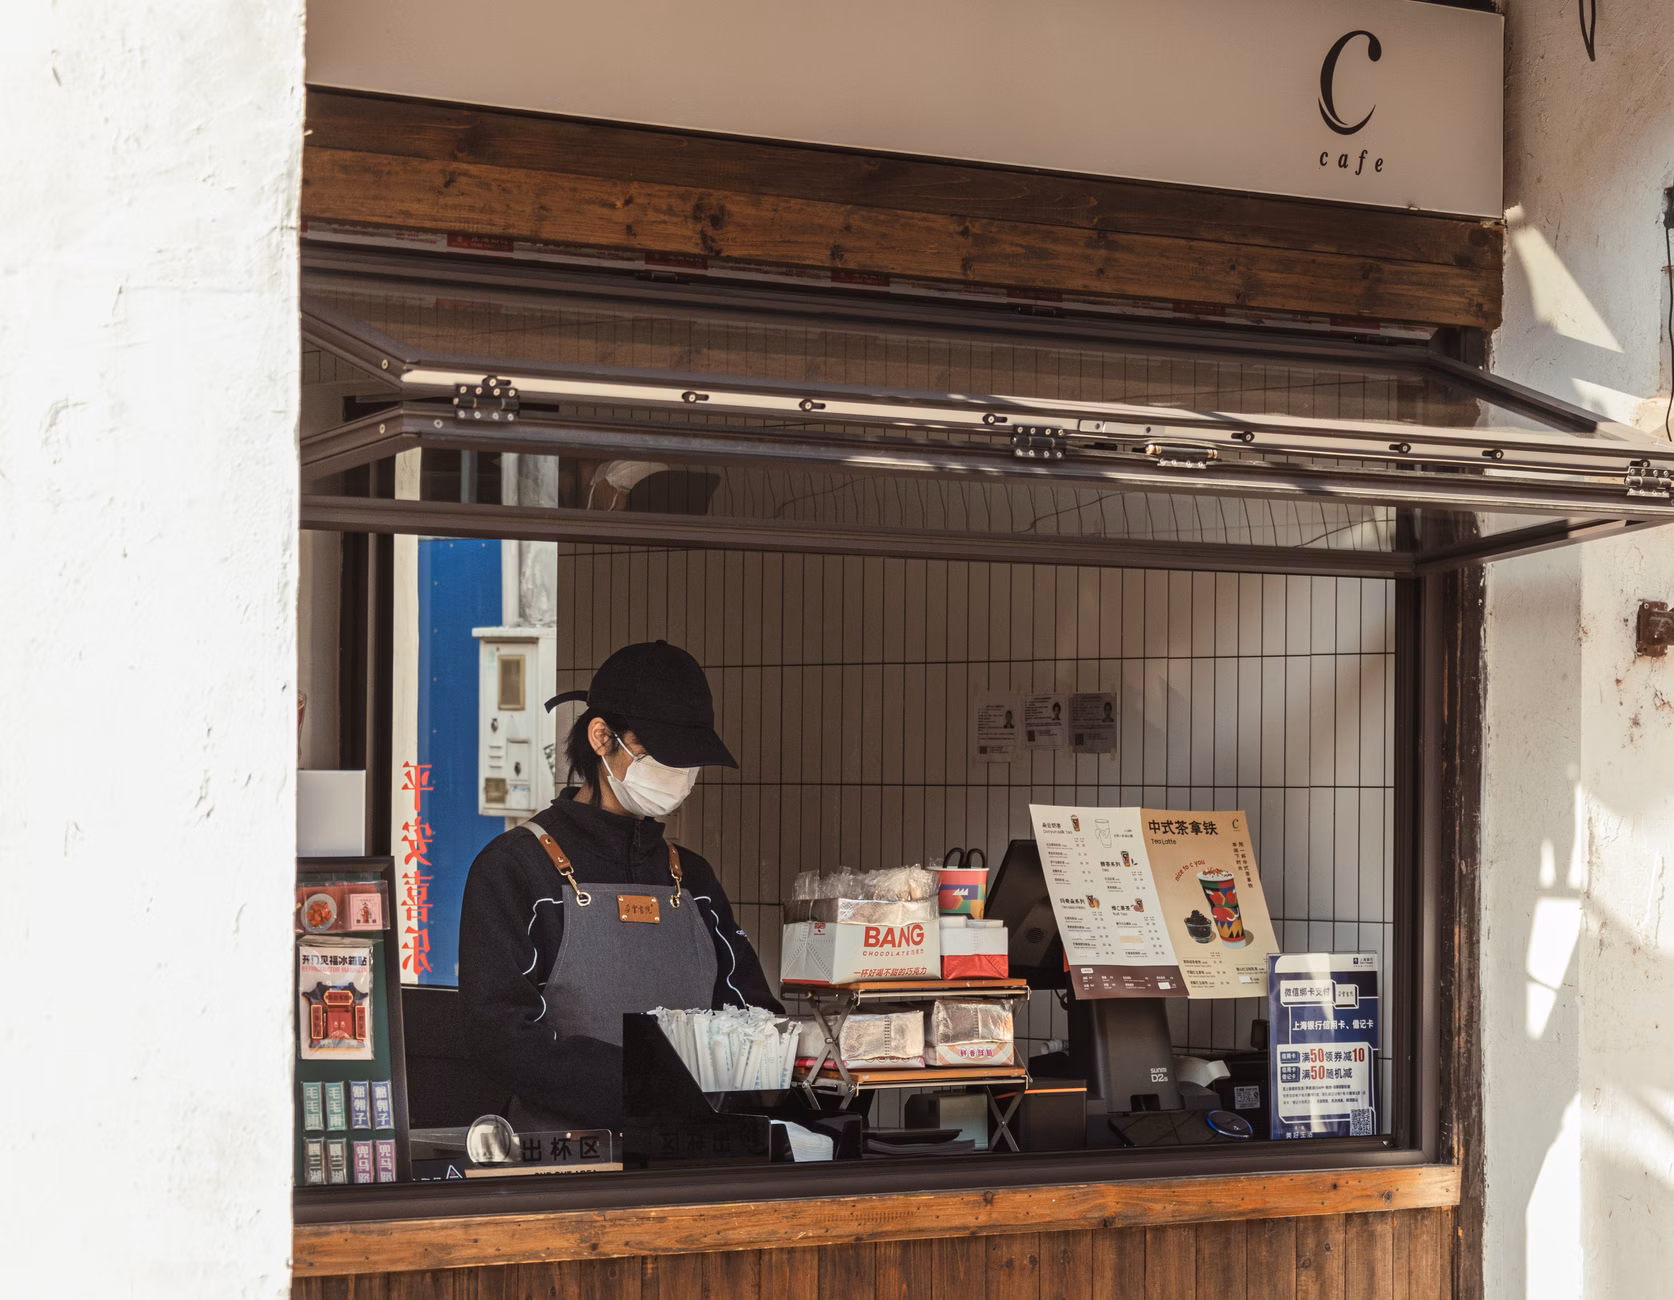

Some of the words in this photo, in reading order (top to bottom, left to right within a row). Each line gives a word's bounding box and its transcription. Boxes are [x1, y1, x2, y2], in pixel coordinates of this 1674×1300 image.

[1318, 30, 1382, 135] C
[1319, 150, 1384, 176] cafe
[1148, 819, 1219, 836] 中式茶拿铁
[1175, 869, 1184, 882] nice
[1195, 859, 1206, 868] you
[863, 924, 925, 948] BANG
[302, 954, 367, 966] 开门见福冰箱贴
[1284, 987, 1331, 997] 微信绑卡支付
[1292, 1019, 1374, 1031] 上海银行信用卡、借记卡
[1281, 1052, 1296, 1060] 信用卡
[1301, 1047, 1365, 1063] 满50领券减10
[1151, 1074, 1168, 1083] D2s
[1301, 1065, 1353, 1081] 满50随机减
[522, 1135, 600, 1162] 出杯区
